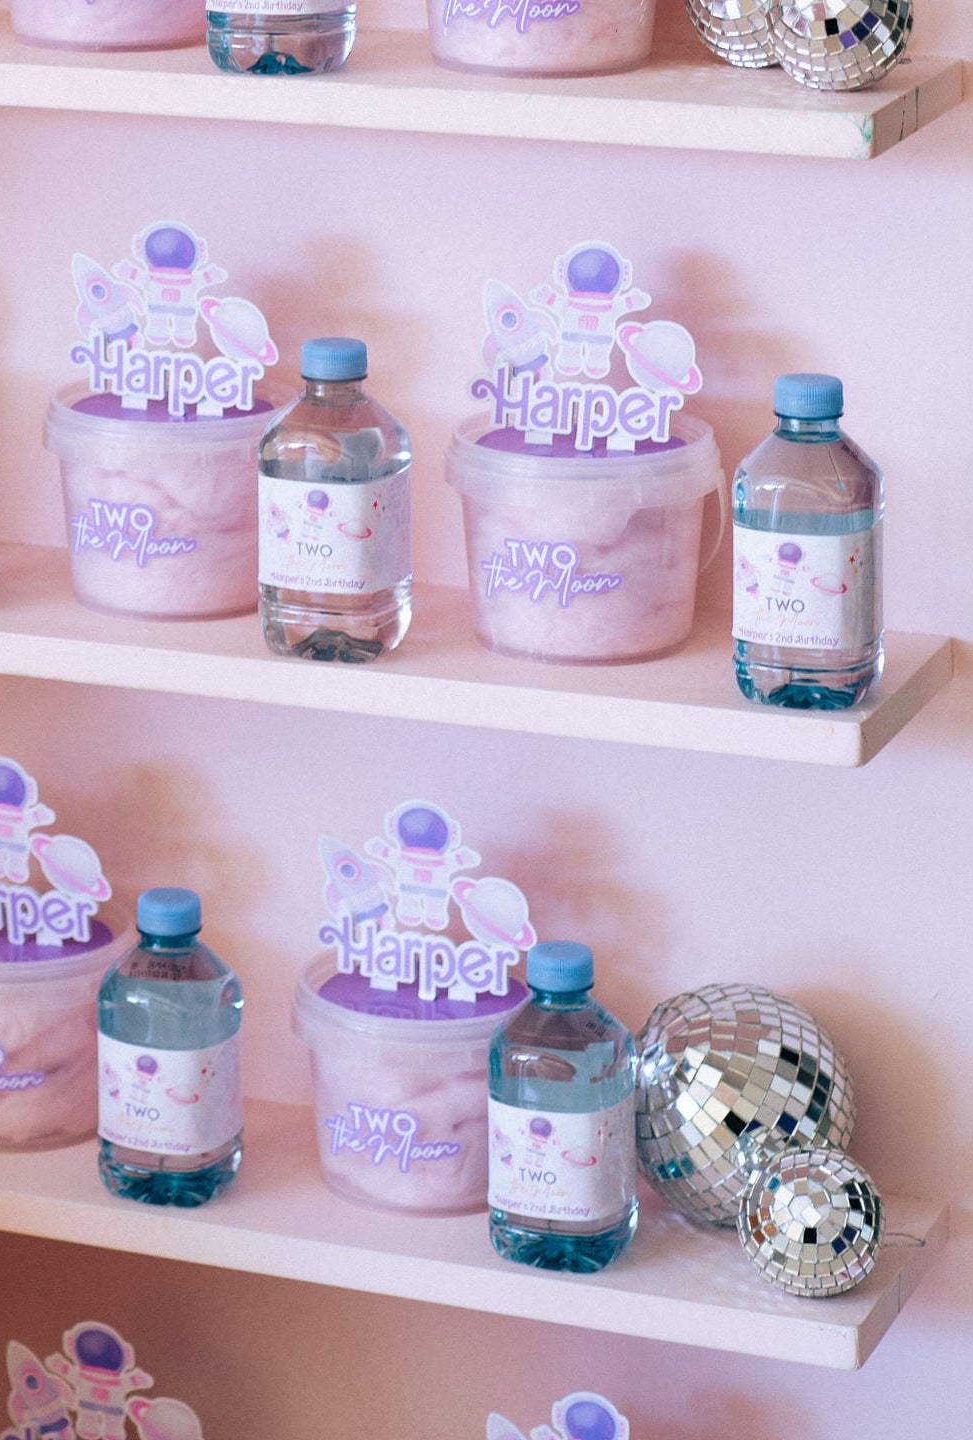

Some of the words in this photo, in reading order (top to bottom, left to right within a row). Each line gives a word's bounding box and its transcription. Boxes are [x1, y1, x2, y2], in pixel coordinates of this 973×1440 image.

[70, 335, 261, 412] Harper
[471, 367, 680, 447] Harper
[90, 502, 154, 531] TWO
[72, 514, 105, 554] the
[107, 528, 195, 567] Moon
[296, 541, 333, 558] TWO
[507, 540, 576, 569] TWO
[483, 555, 523, 596] the
[525, 566, 620, 606] Moon
[765, 596, 805, 613] TWO
[795, 634, 839, 647] Birthday
[319, 915, 516, 993] Harper
[124, 1103, 160, 1121] TWO
[348, 1104, 417, 1136] TWO
[327, 1116, 366, 1153] the
[368, 1134, 460, 1172] Moon
[518, 1167, 557, 1185] TWO
